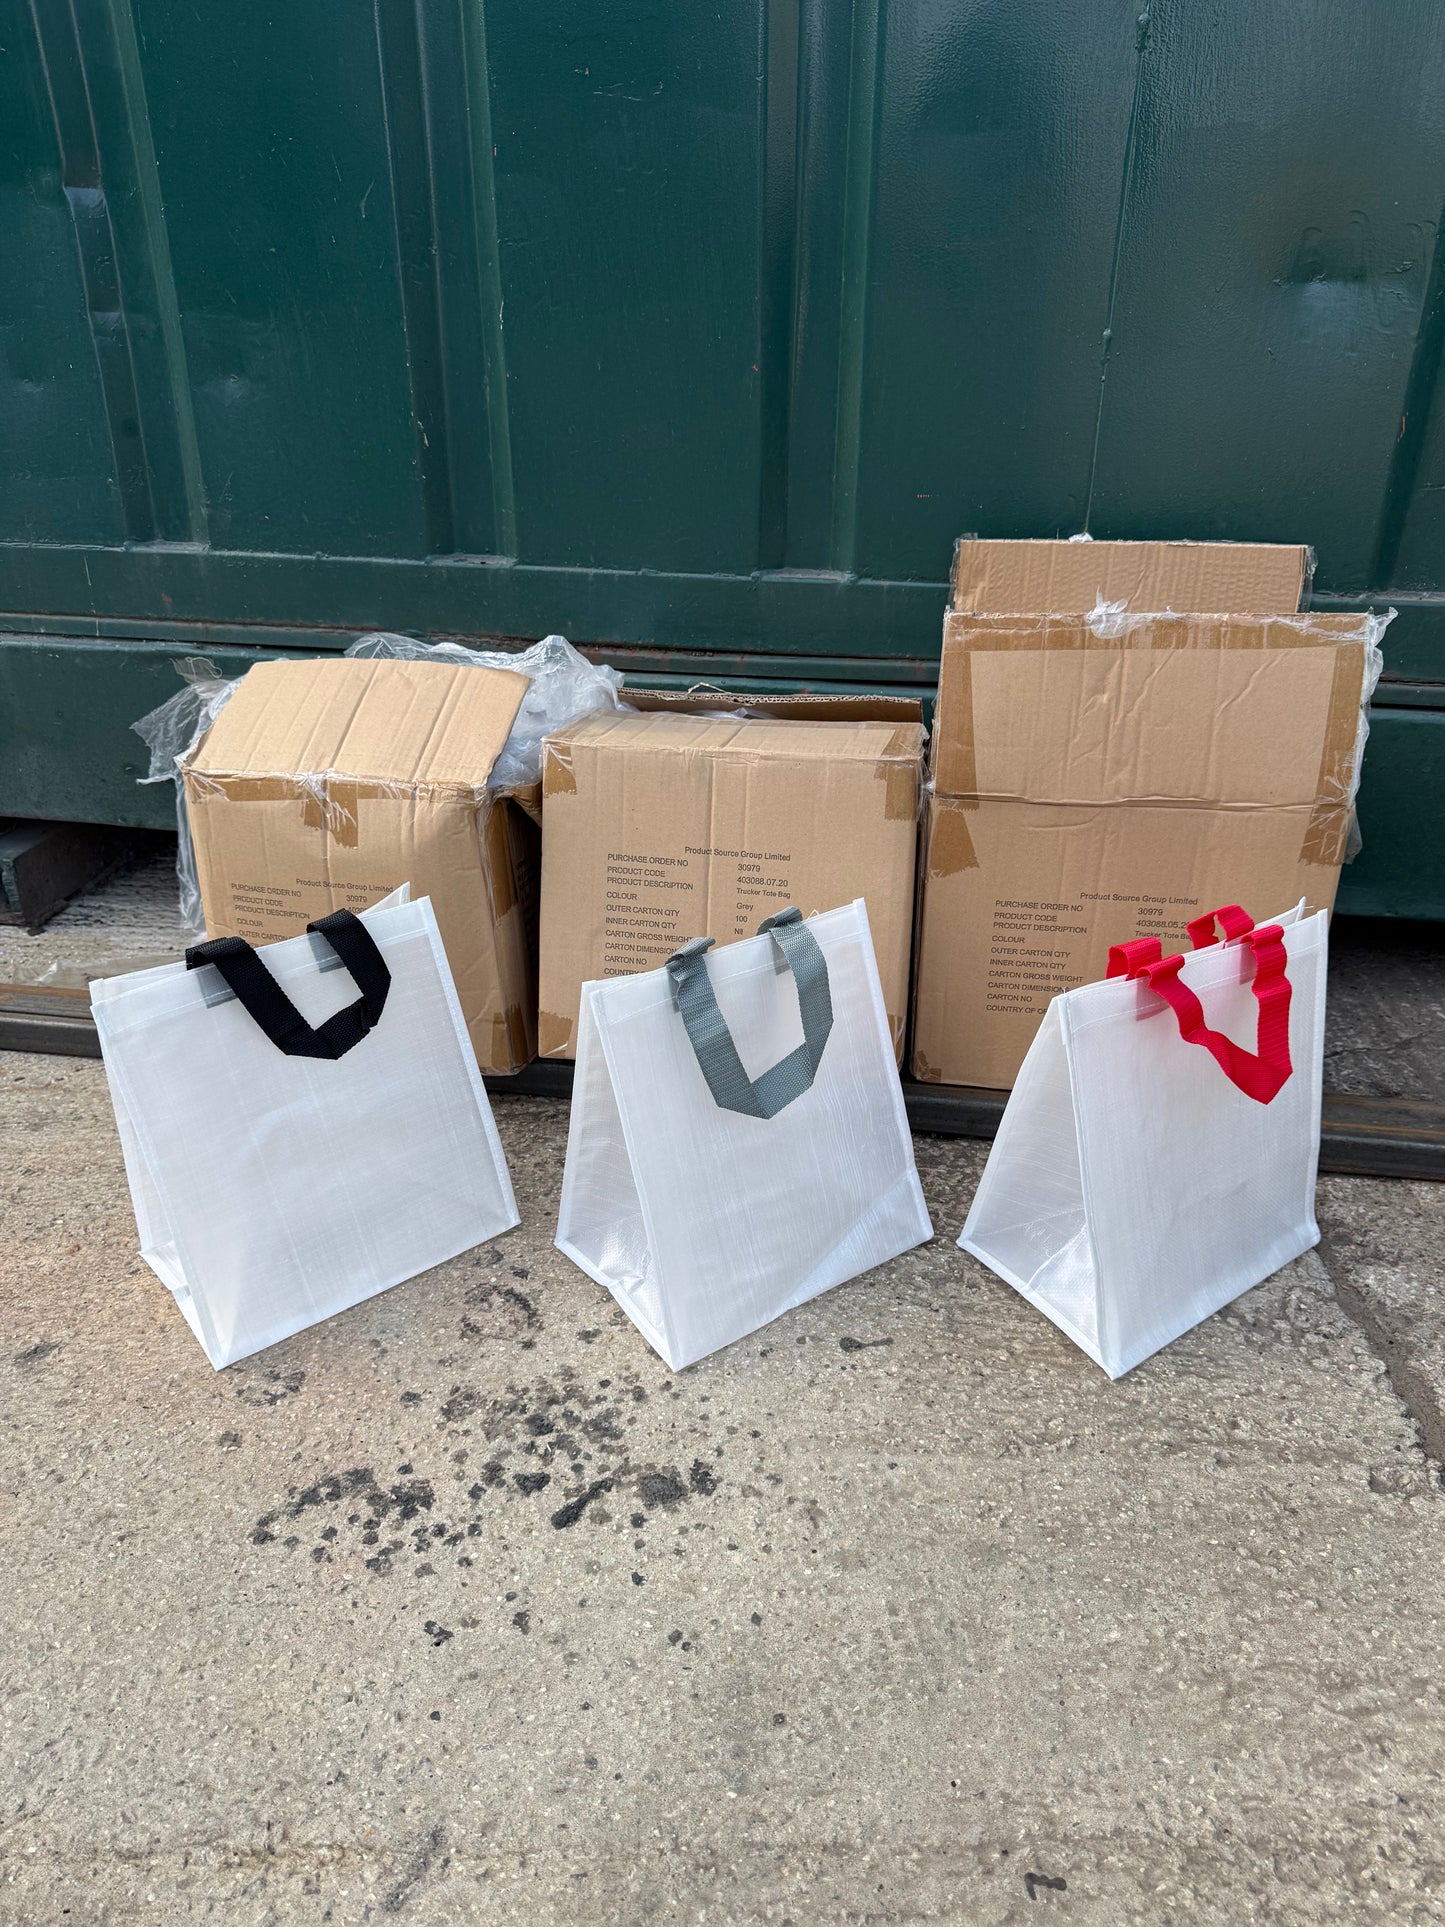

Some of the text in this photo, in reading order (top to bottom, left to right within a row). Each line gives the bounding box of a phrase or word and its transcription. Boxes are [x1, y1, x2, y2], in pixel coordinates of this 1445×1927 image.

[684, 846, 790, 861] Product Source Group Limited
[607, 853, 689, 867] PURCHASE ORDER NO
[607, 866, 666, 877] PRODUCT CODE
[738, 864, 760, 872] 30979
[296, 878, 321, 887] Product
[346, 883, 367, 891] Group
[368, 884, 393, 892] Limited
[607, 877, 693, 890] PRODUCT DESCRIPTION
[737, 876, 788, 887] 403088.07.20
[231, 883, 266, 893] PURCHASE
[266, 887, 290, 896] ORDER
[233, 895, 263, 905] PRODUCT
[345, 894, 368, 903] 30979
[606, 891, 637, 900] COLOUR
[778, 891, 791, 899] Bag
[1080, 892, 1198, 905] Product Source Group Limited
[606, 904, 680, 917] OUTER CARTON QTY
[736, 902, 754, 911] Grey
[995, 900, 1083, 912] PURCHASE ORDER NO
[234, 905, 310, 919] PRODUCT DESCRIPTION
[994, 912, 1057, 922] PRODUCT CODE
[1138, 908, 1163, 916] 30979
[236, 918, 263, 927] COLOUR
[605, 917, 628, 925] INNER
[629, 919, 660, 928] CARTON
[736, 915, 748, 923] 100
[993, 921, 1087, 934] PRODUCT DESCRIPTION
[1136, 920, 1189, 929] 403088.05.2
[239, 930, 260, 938] OUTER
[605, 929, 636, 939] CARTON
[636, 932, 663, 941] GROSS
[992, 935, 1025, 943] COLOUR
[1135, 930, 1161, 938] Trucker
[605, 942, 676, 954] CARTON DIMENSION
[991, 947, 1071, 958] OUTER CARTON QTY
[604, 955, 635, 963] CARTON
[1015, 960, 1048, 968] CARTON
[1049, 962, 1066, 970] QTY
[989, 970, 1084, 982] CARTON GROSS WEIGHT
[988, 981, 1020, 990] CARTON
[987, 993, 1019, 1001] CARTON
[986, 1004, 1024, 1013] COUNTRY
